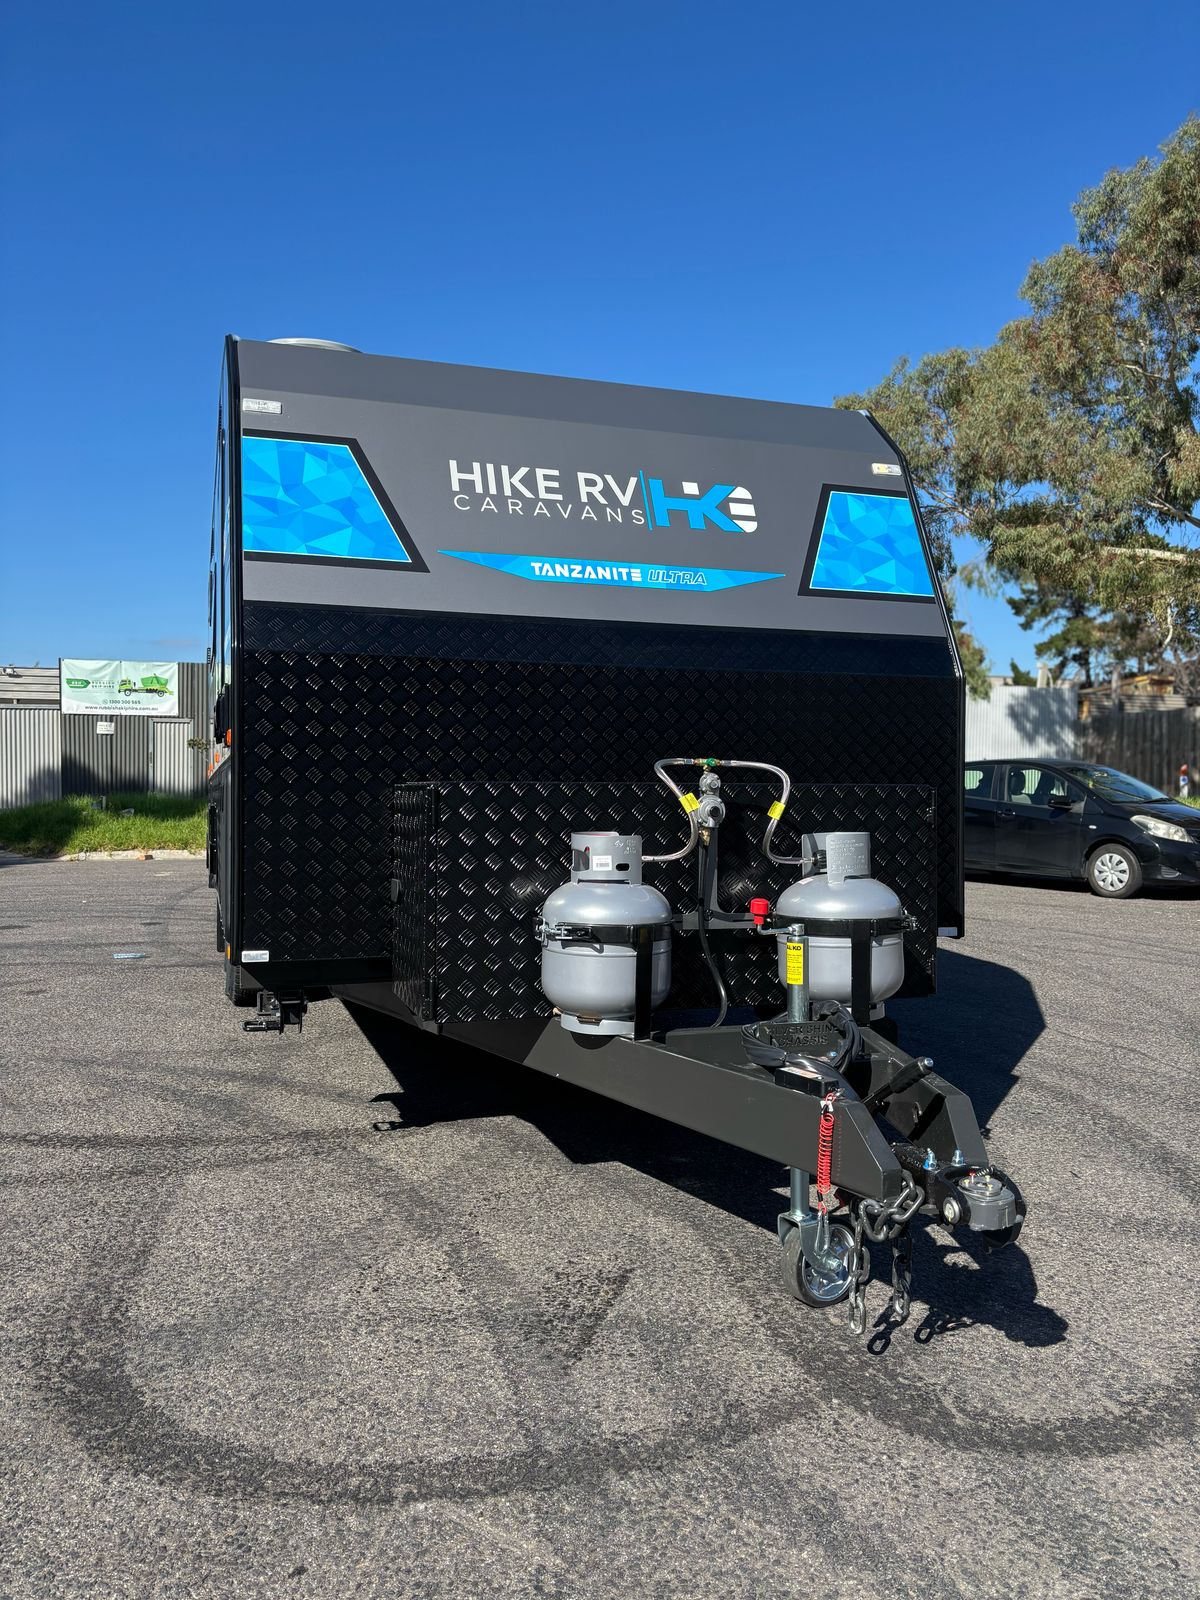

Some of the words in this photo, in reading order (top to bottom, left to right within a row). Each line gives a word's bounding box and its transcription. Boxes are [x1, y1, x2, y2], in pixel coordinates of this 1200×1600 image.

[449, 460, 563, 500] HIKE
[577, 472, 637, 507] RV
[454, 495, 645, 525] CARAVANS
[531, 562, 642, 582] TANZANITE
[648, 570, 707, 585] ULTRA
